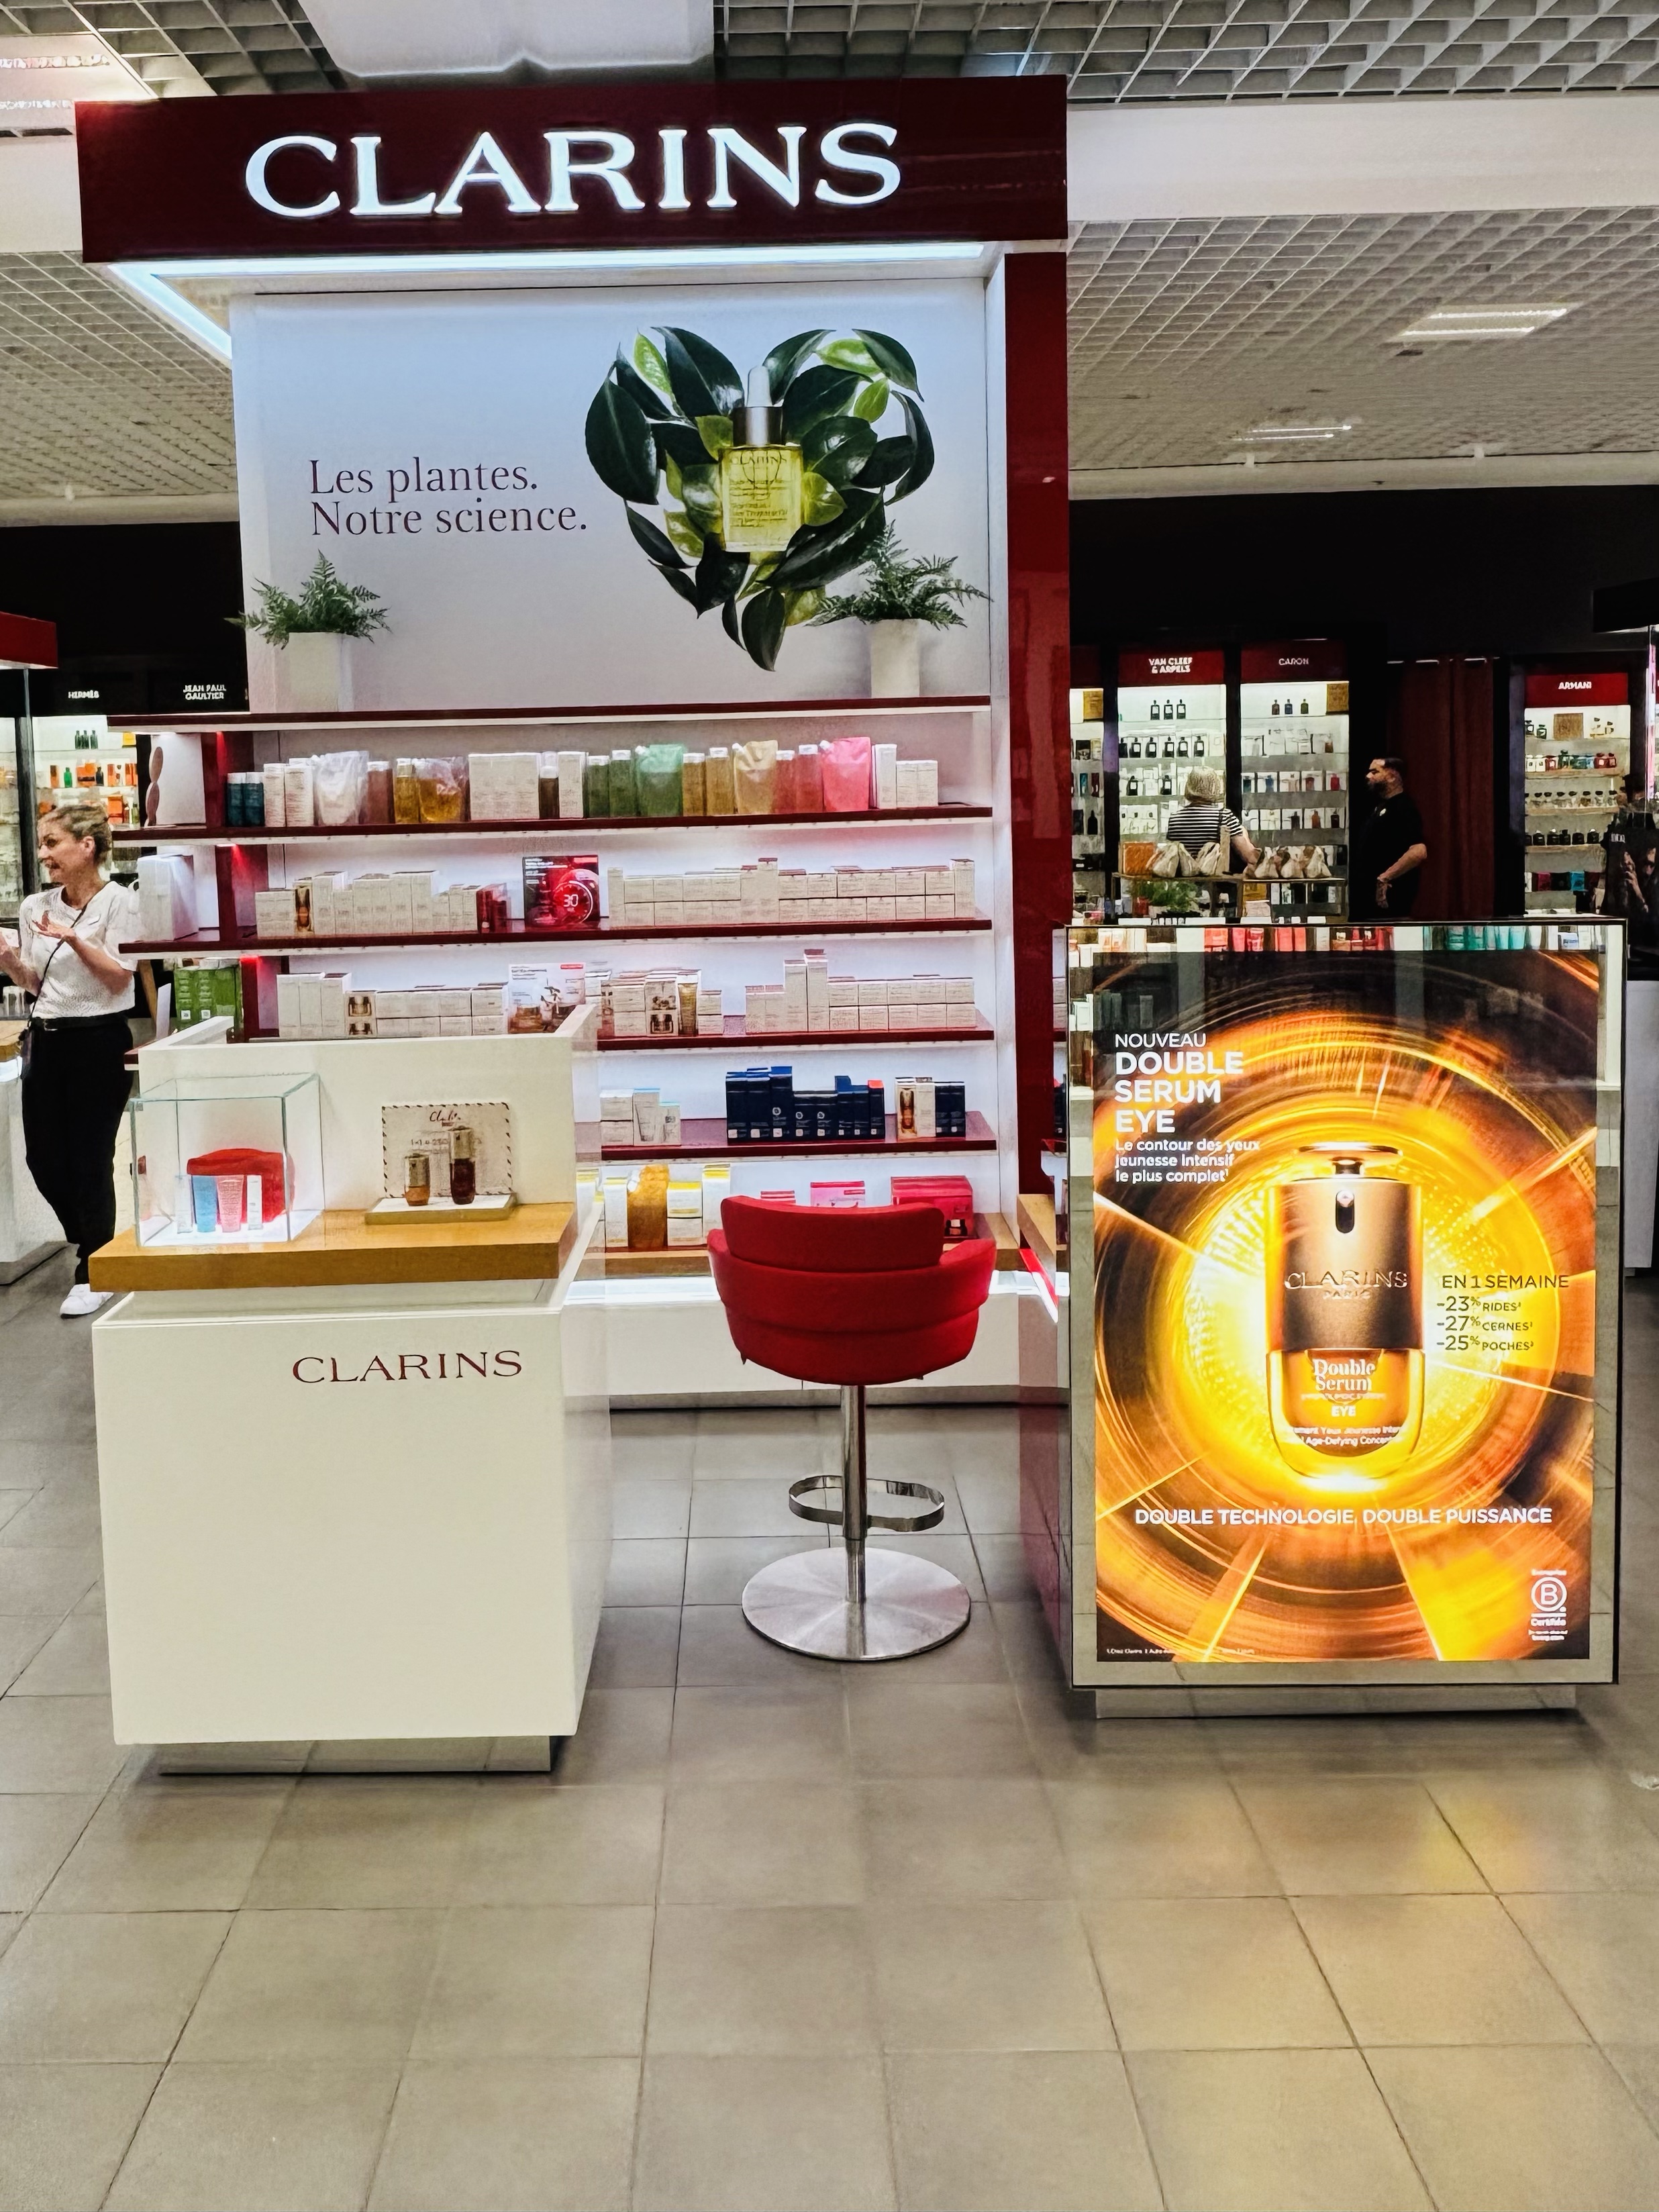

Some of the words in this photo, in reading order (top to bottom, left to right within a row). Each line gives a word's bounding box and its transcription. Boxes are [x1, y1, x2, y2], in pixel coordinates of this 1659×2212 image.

[246, 122, 901, 218] CLARINS
[309, 460, 373, 494] Les
[387, 457, 538, 503] plantes.
[311, 501, 422, 536] Notre
[436, 497, 587, 534] science.
[1149, 658, 1166, 666] VAN
[183, 685, 203, 693] JEAN
[185, 692, 224, 700] GAULTIER
[1115, 1033, 1206, 1048] NOUVEAU
[1115, 1051, 1244, 1075] DOUBLE
[1114, 1079, 1221, 1103] SERUM
[1116, 1109, 1175, 1133] EYE
[1115, 1139, 1133, 1152] Le
[1137, 1140, 1194, 1152] contour
[1197, 1138, 1223, 1152] des
[1226, 1140, 1261, 1153] yeux
[1115, 1154, 1178, 1168] jeunesse
[1182, 1154, 1236, 1167] intensif
[1115, 1170, 1129, 1183] le
[1132, 1170, 1163, 1185] plus
[1285, 1269, 1407, 1290] CLARINS
[1443, 1275, 1466, 1289] EN
[1471, 1275, 1481, 1289] 1
[1485, 1275, 1570, 1289] SEMAINE
[1437, 1296, 1481, 1311] -23%
[1437, 1315, 1481, 1331] -27%
[1437, 1335, 1480, 1350] -25%
[293, 1350, 522, 1383] CLARINS
[1312, 1358, 1376, 1376] Double
[1315, 1375, 1372, 1391] Serum
[1331, 1405, 1356, 1417] EYE
[1136, 1509, 1213, 1525] DOUBLE
[1363, 1508, 1441, 1524] DOUBLE
[1446, 1507, 1552, 1524] PUISSANCE
